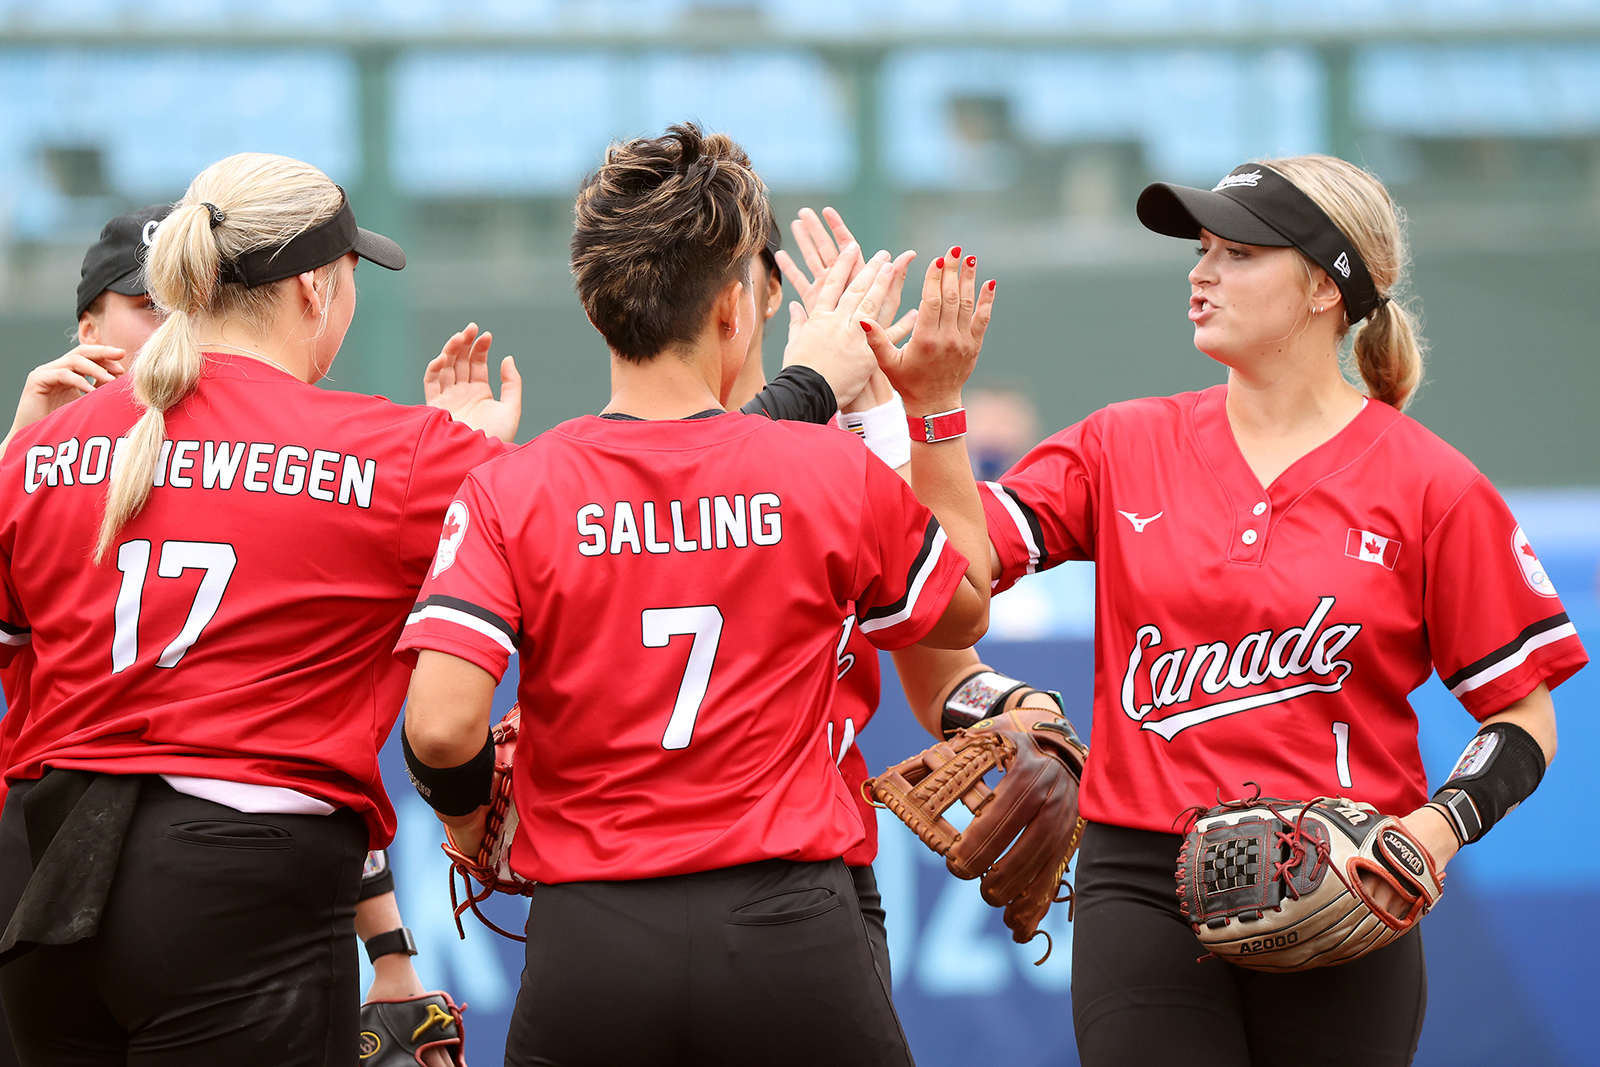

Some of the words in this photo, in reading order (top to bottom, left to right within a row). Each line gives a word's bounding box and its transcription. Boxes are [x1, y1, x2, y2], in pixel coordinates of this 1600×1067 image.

[23, 435, 377, 510] GROEWEGEN
[575, 492, 784, 558] SALLING
[110, 538, 238, 676] 17
[641, 604, 726, 752] 7
[1121, 596, 1362, 726] Canada
[1331, 721, 1353, 789] 1
[1384, 833, 1423, 875] Wilson
[1240, 930, 1299, 954] A2000
